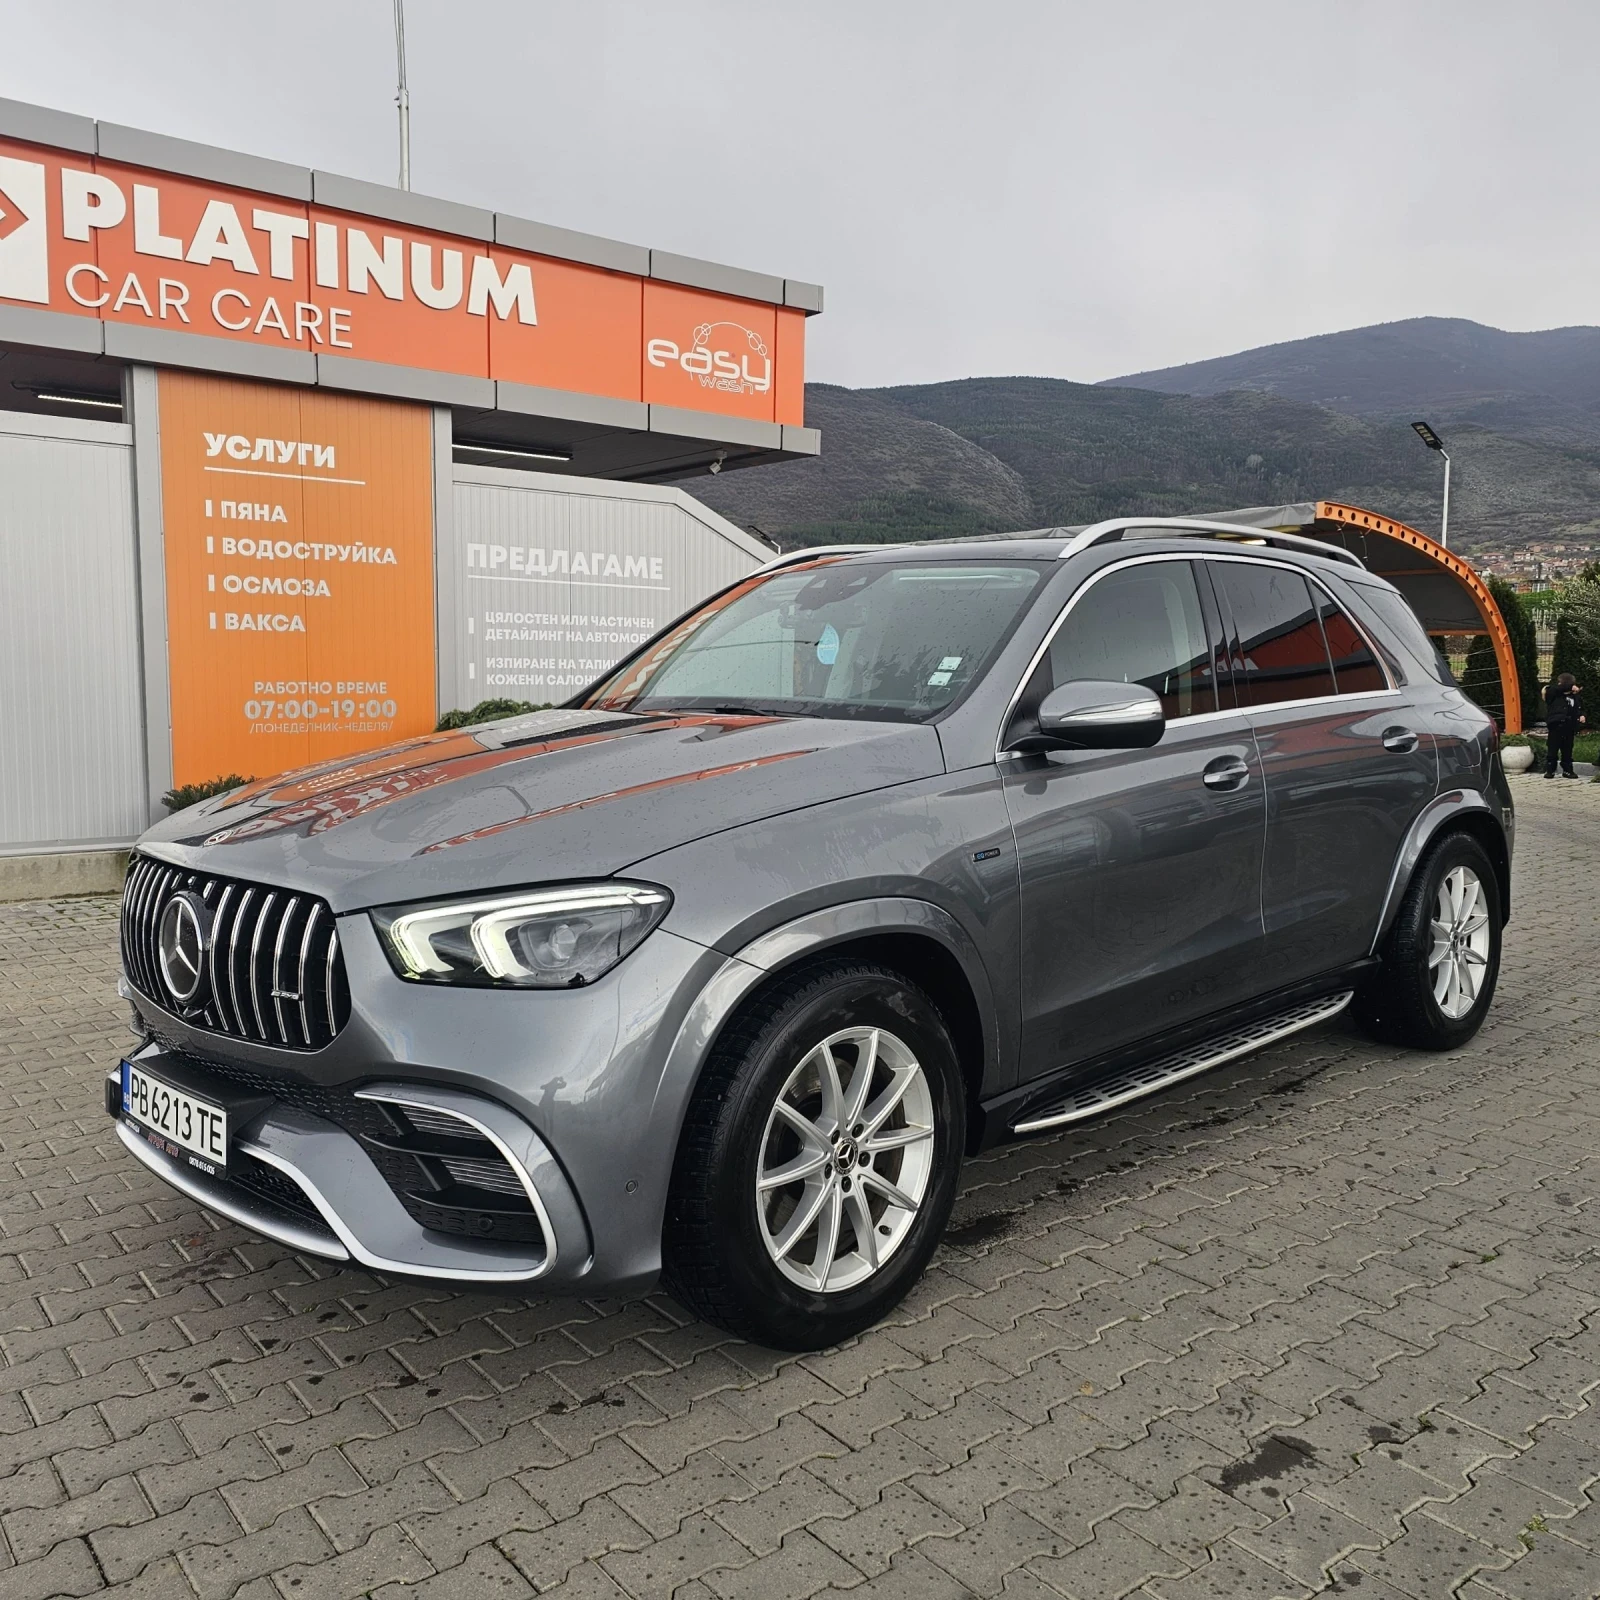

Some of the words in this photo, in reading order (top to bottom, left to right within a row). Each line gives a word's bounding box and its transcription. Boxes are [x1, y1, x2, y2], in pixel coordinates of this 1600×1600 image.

[61, 167, 537, 326] PLATINUM
[65, 264, 190, 323] CAR
[211, 289, 353, 349] CARE
[648, 339, 771, 391] easy
[698, 375, 754, 395] wash
[203, 432, 336, 469] УСЛУГИ
[221, 500, 288, 523] ПЯНА
[222, 537, 398, 565] ВОДОСТРУЙКА
[467, 542, 664, 580] ПРЕДЛАГАМЕ
[223, 574, 332, 597] ОСМОЗА
[224, 612, 306, 632] ВАКСА
[485, 611, 559, 625] ЦЯЛОСТЕН
[561, 614, 588, 626] ИЛИ
[590, 615, 655, 629] ЧАСТИЧЕН
[485, 627, 564, 642] ДЕТАЙЛИНГ
[566, 631, 584, 643] НА
[486, 657, 556, 669] ИЗПИРАНЕ
[558, 658, 577, 670] НА
[254, 681, 333, 694] РАБОТНО
[336, 682, 387, 694] ВРЕМЕ
[486, 673, 544, 686] КОЖЕНИ
[244, 699, 397, 719] 07:00-19:00
